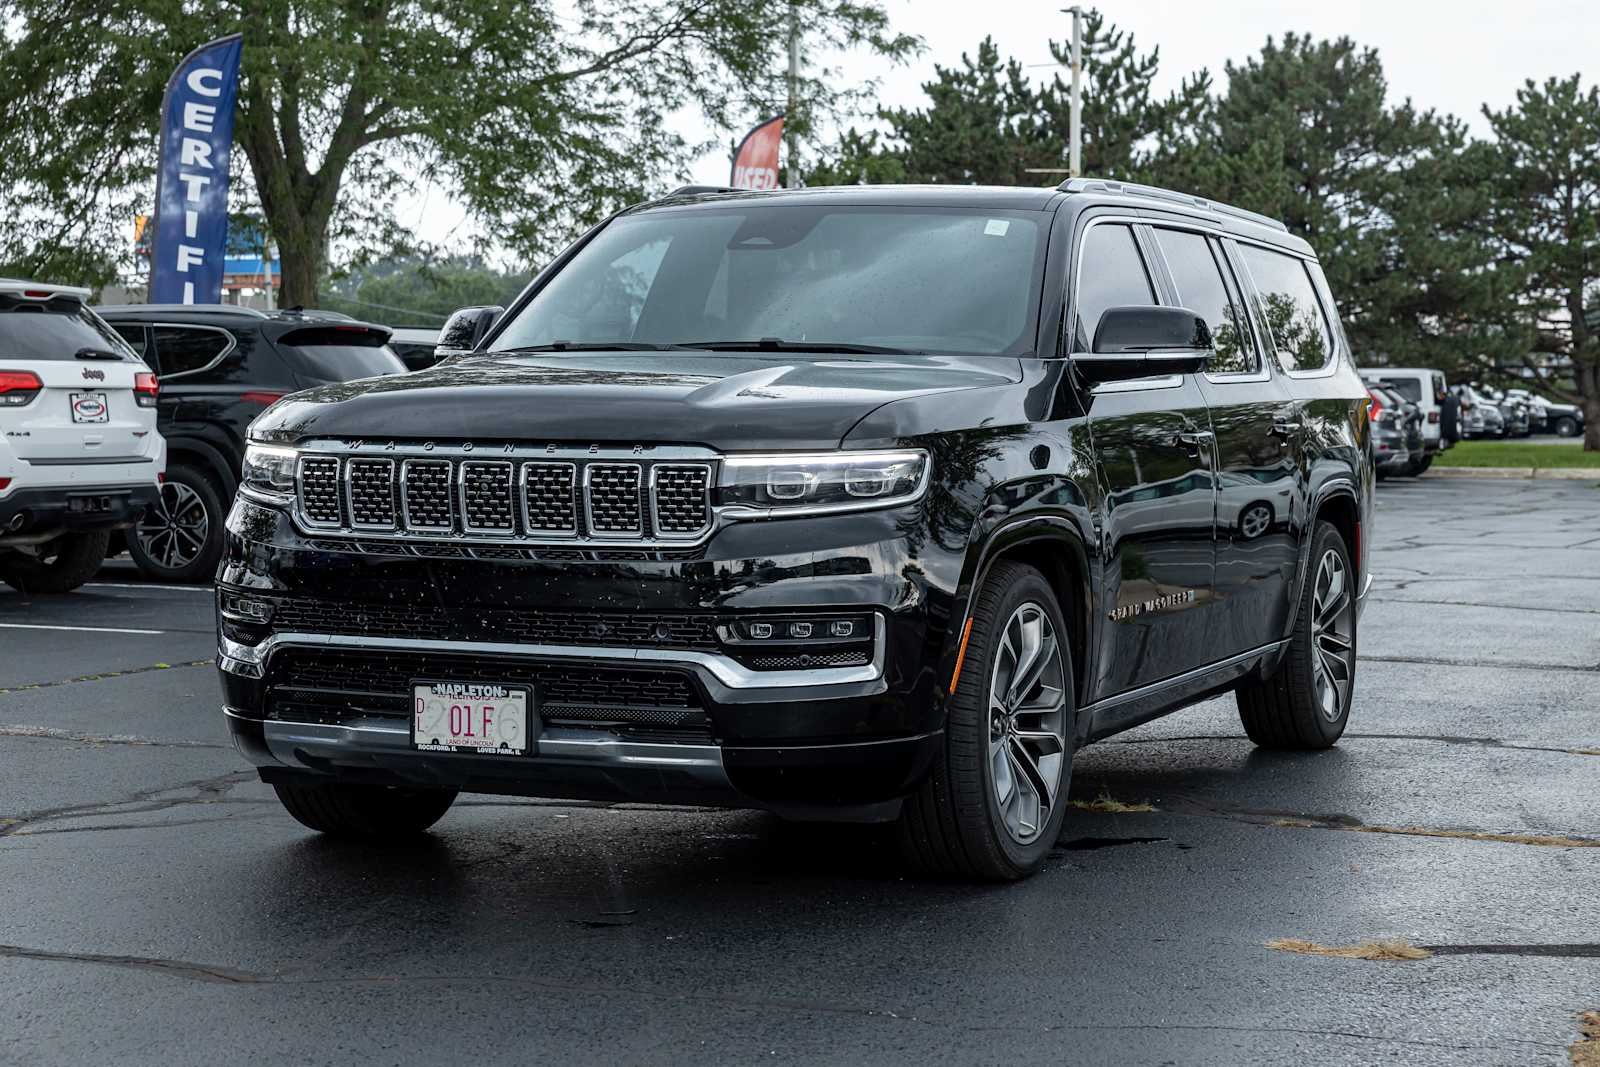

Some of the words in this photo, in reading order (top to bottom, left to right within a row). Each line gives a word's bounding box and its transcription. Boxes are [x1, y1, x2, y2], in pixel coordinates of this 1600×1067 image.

[81, 367, 105, 382] Jeep
[346, 440, 644, 454] WAGONEER
[436, 683, 502, 697] NAPLETON
